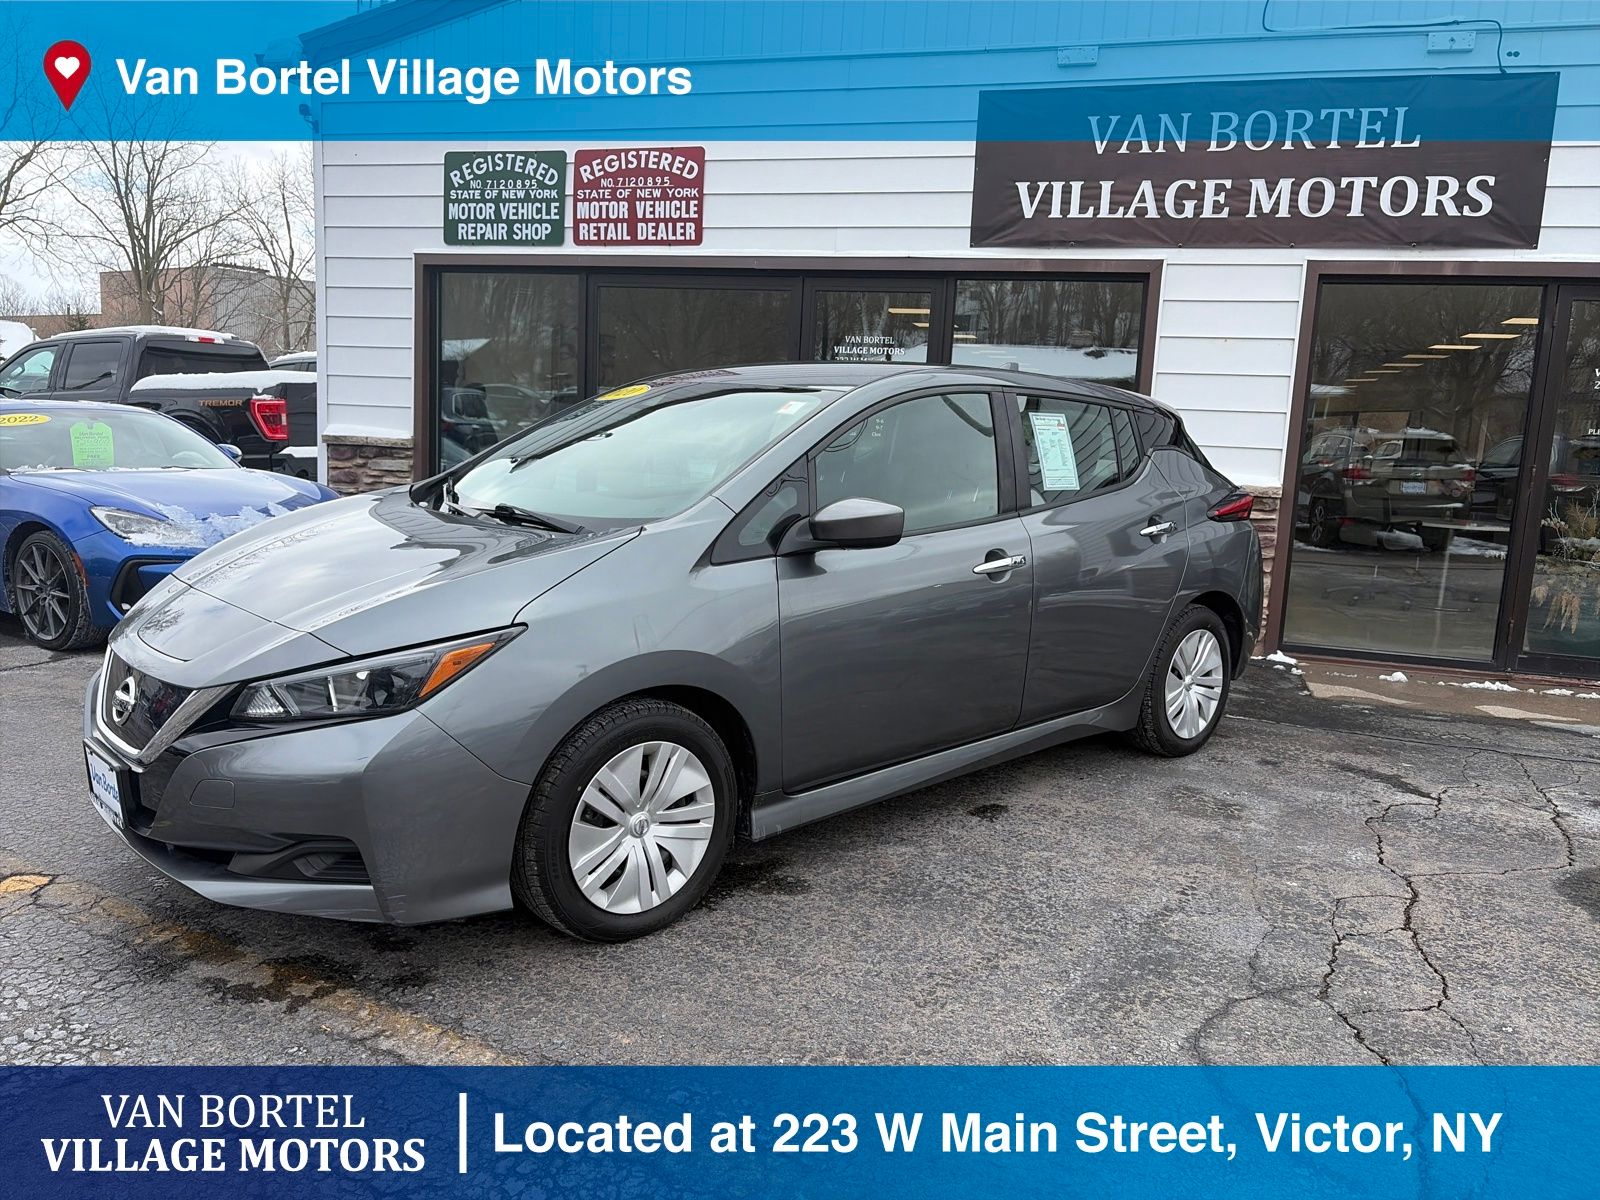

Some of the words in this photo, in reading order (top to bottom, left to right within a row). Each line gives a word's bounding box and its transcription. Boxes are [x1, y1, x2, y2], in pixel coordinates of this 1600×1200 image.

[1088, 113, 1191, 155] VAN
[1206, 106, 1421, 152] BORTEL
[450, 153, 559, 188] REGISTERED
[579, 150, 699, 184] REGISTERED
[470, 180, 483, 189] NO.
[486, 179, 538, 189] 7120895
[600, 178, 614, 187] NO.
[617, 177, 671, 187] 7120895
[450, 190, 481, 199] STATE
[486, 190, 499, 199] OF
[502, 190, 525, 199] NEW
[529, 189, 558, 199] YORK
[577, 189, 611, 199] STATE
[616, 189, 632, 198] OF
[636, 189, 662, 198] NEW
[667, 188, 699, 198] YORK
[1015, 178, 1232, 219] VILLAGE
[1246, 175, 1496, 218] MOTORS
[448, 203, 495, 220] MOTOR
[500, 202, 560, 220] VEHICLE
[576, 201, 629, 219] MOTOR
[635, 200, 698, 219] VEHICLE
[458, 224, 507, 240] REPAIR
[512, 223, 552, 240] SHOP
[579, 223, 631, 241] RETAIL
[637, 222, 696, 240] DEALER
[863, 336, 895, 344] BORTEL
[834, 346, 868, 354] VILLAGE
[869, 347, 905, 355] MOTORS
[0, 415, 39, 424] 2022
